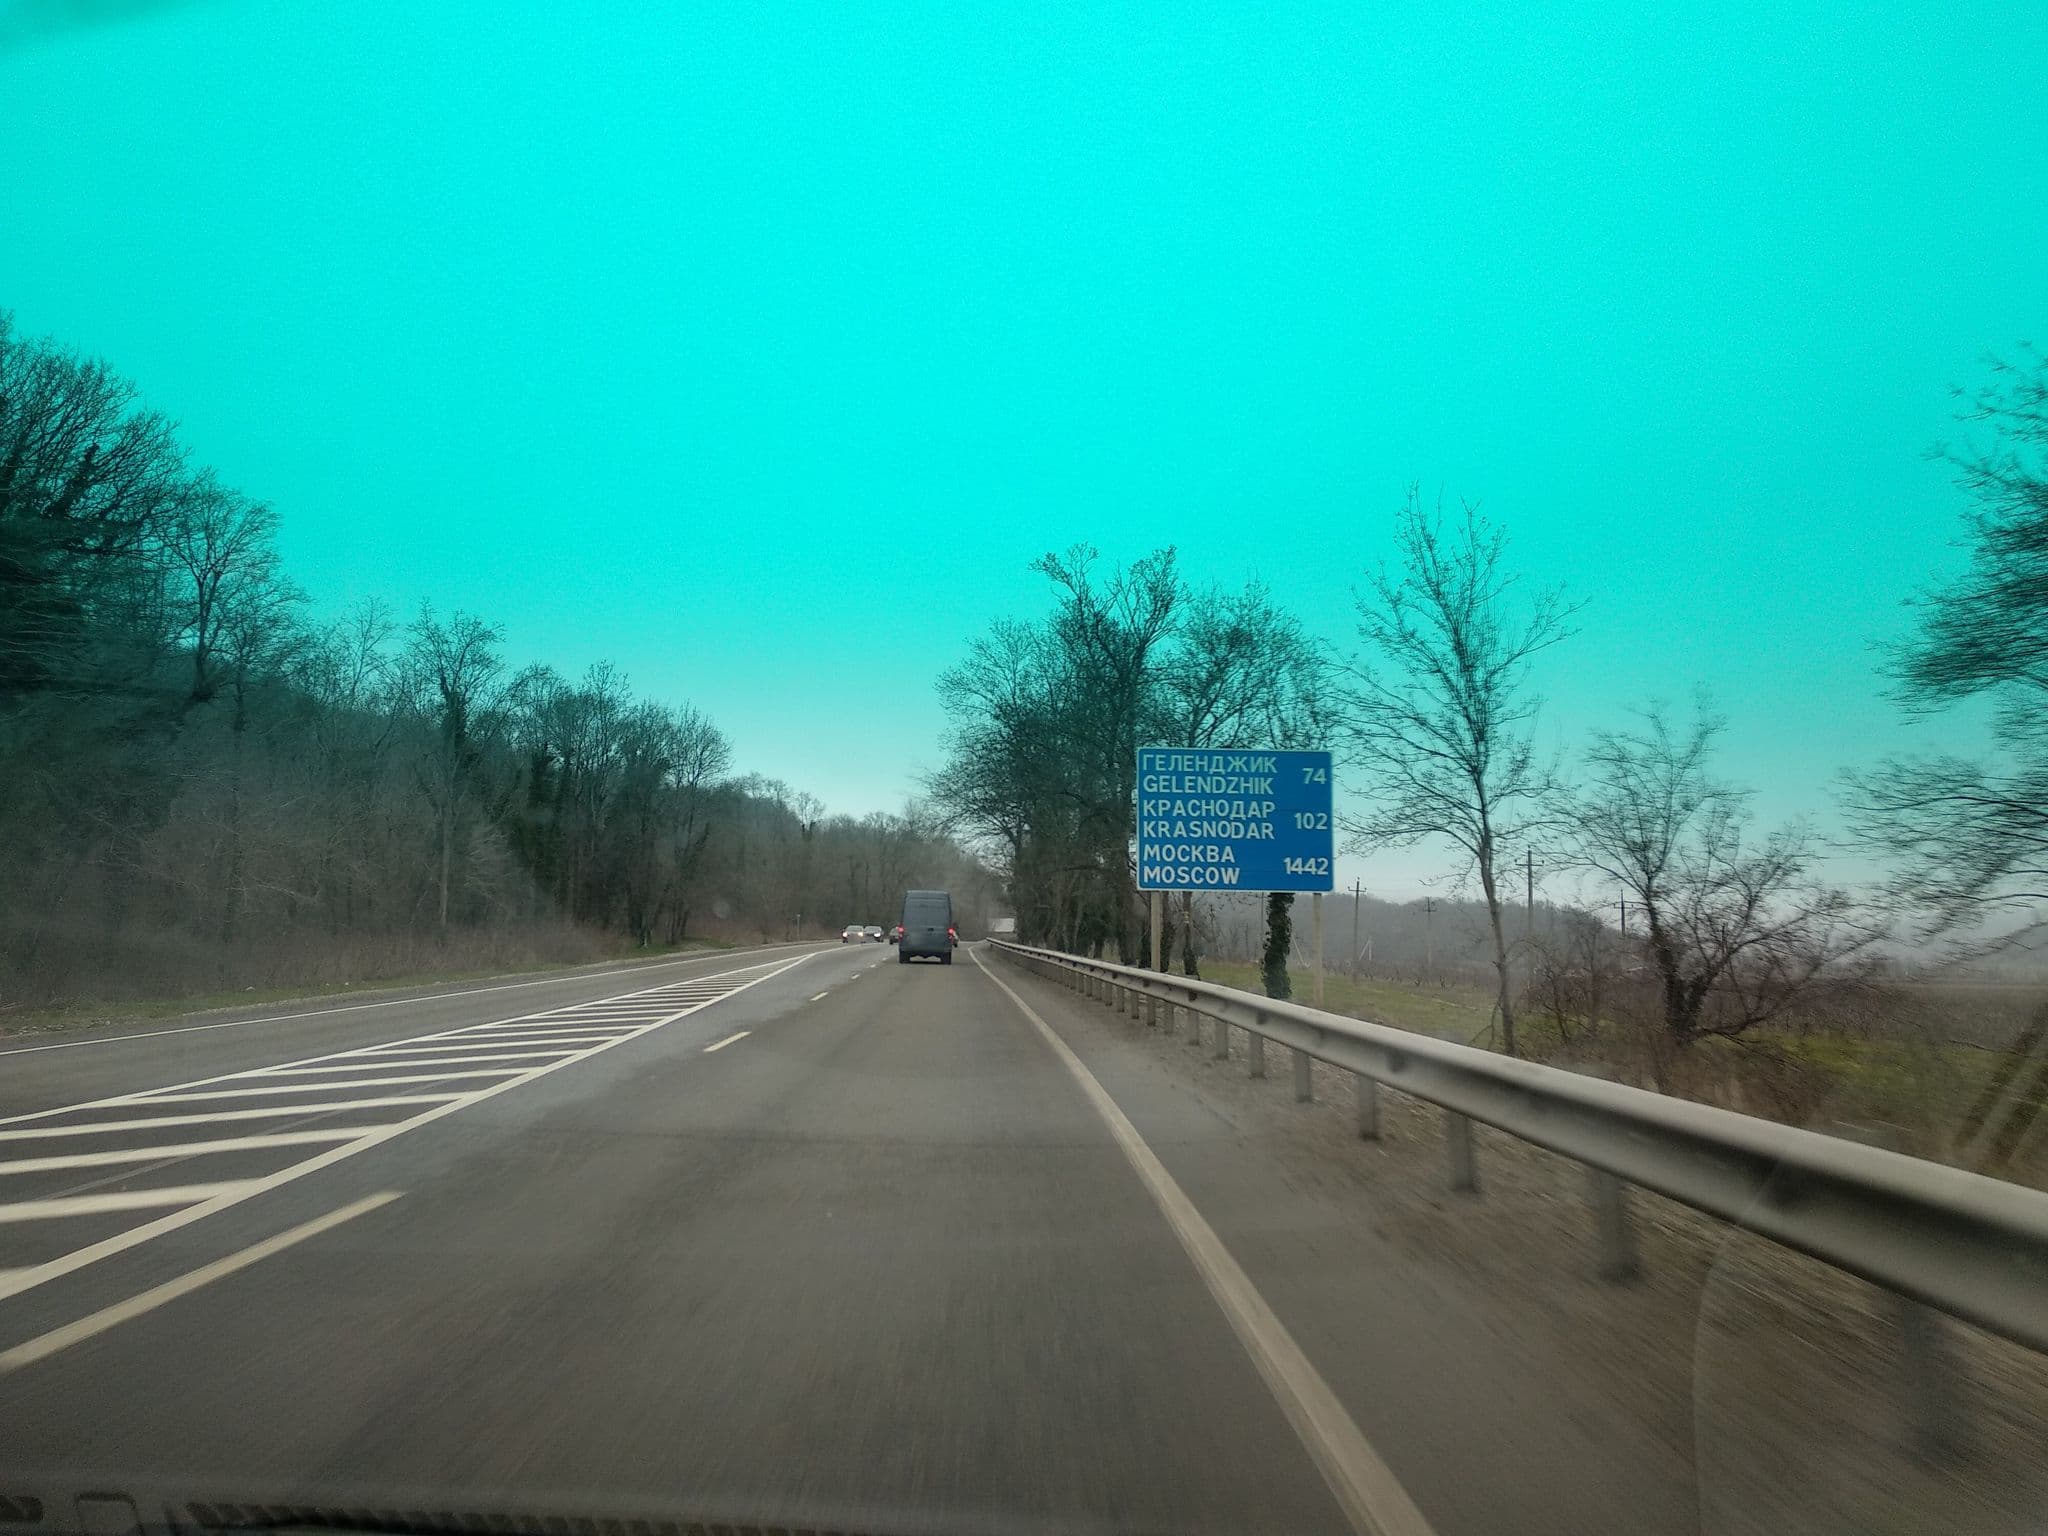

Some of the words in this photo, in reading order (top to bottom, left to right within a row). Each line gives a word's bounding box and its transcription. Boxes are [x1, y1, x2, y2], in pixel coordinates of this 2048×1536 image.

[1143, 754, 1278, 774] ГЕЛЕНДЖИК
[1143, 775, 1274, 795] GELENDZHIK
[1302, 767, 1327, 785] 74
[1143, 799, 1276, 820] КРАСНОДАР
[1143, 820, 1275, 840] KRASNODAR
[1294, 812, 1328, 830] 102
[1143, 844, 1236, 863] МОСКВА
[1143, 866, 1240, 885] MOSCOW
[1283, 857, 1329, 875] 1442
